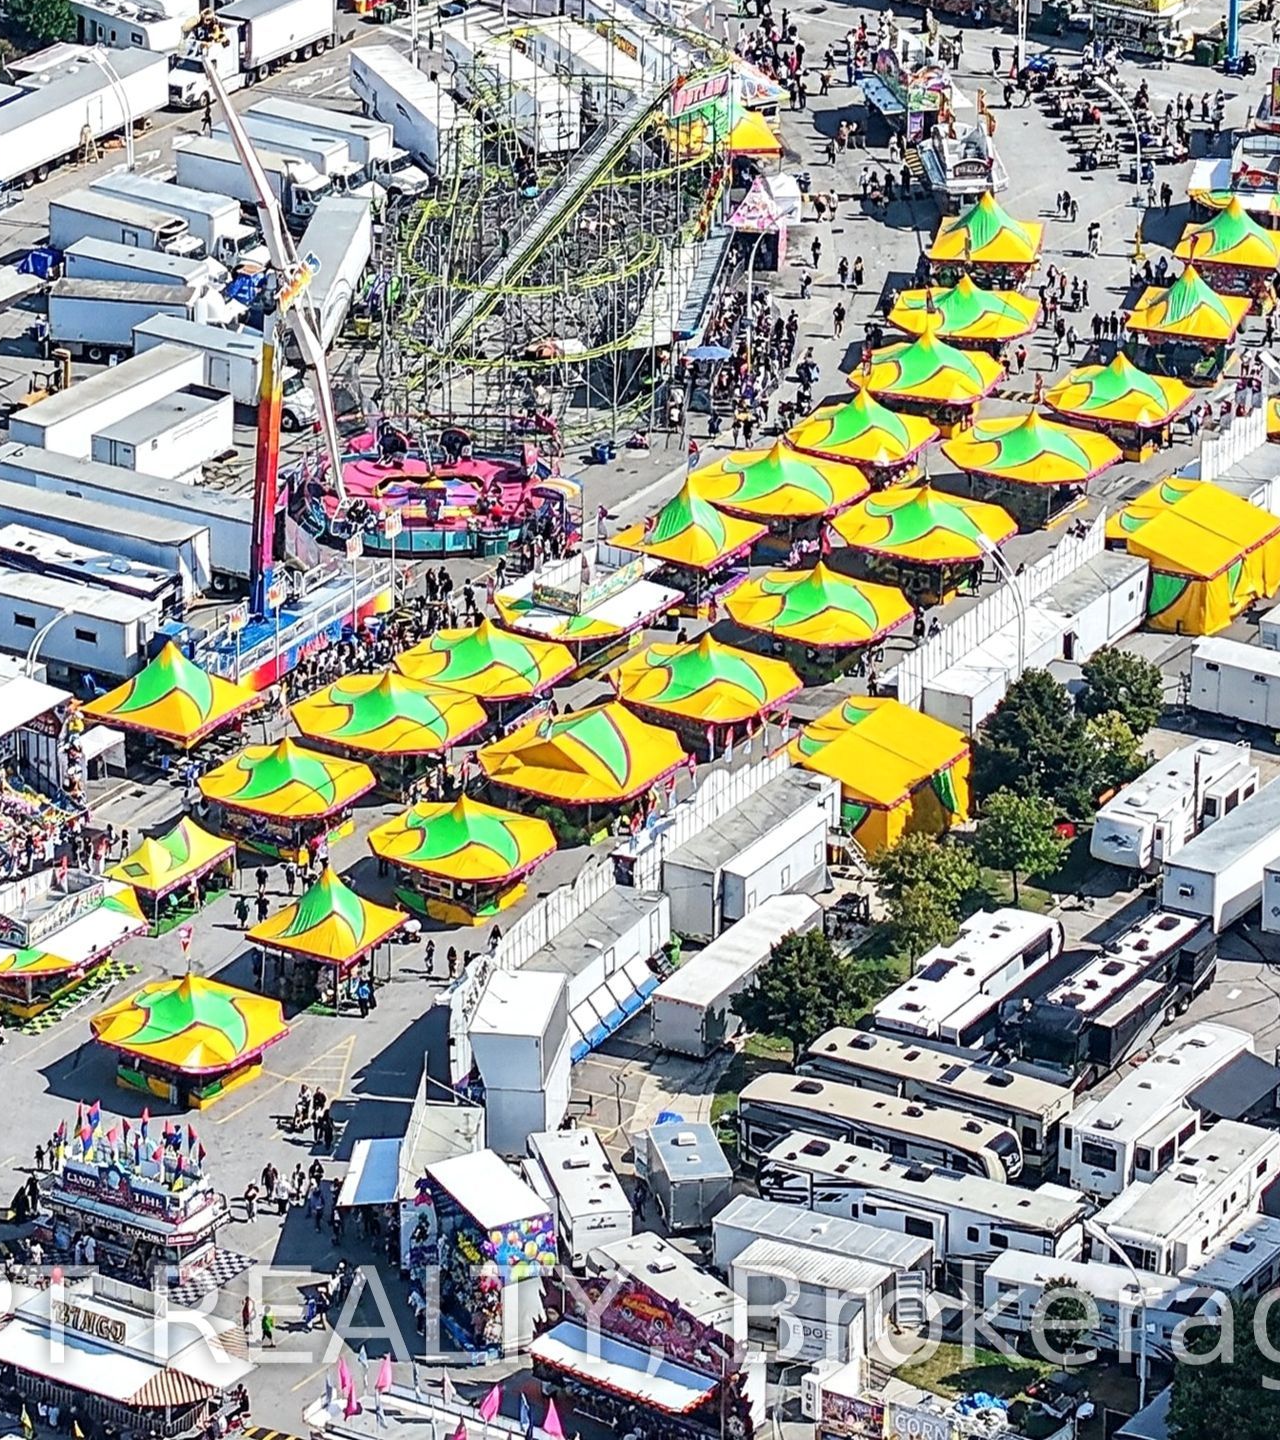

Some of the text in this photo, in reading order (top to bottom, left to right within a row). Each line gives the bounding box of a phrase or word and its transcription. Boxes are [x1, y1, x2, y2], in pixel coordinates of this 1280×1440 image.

[52, 1298, 127, 1346] BINGO
[792, 1323, 833, 1343] EDGE
[894, 1413, 949, 1440] CORN
